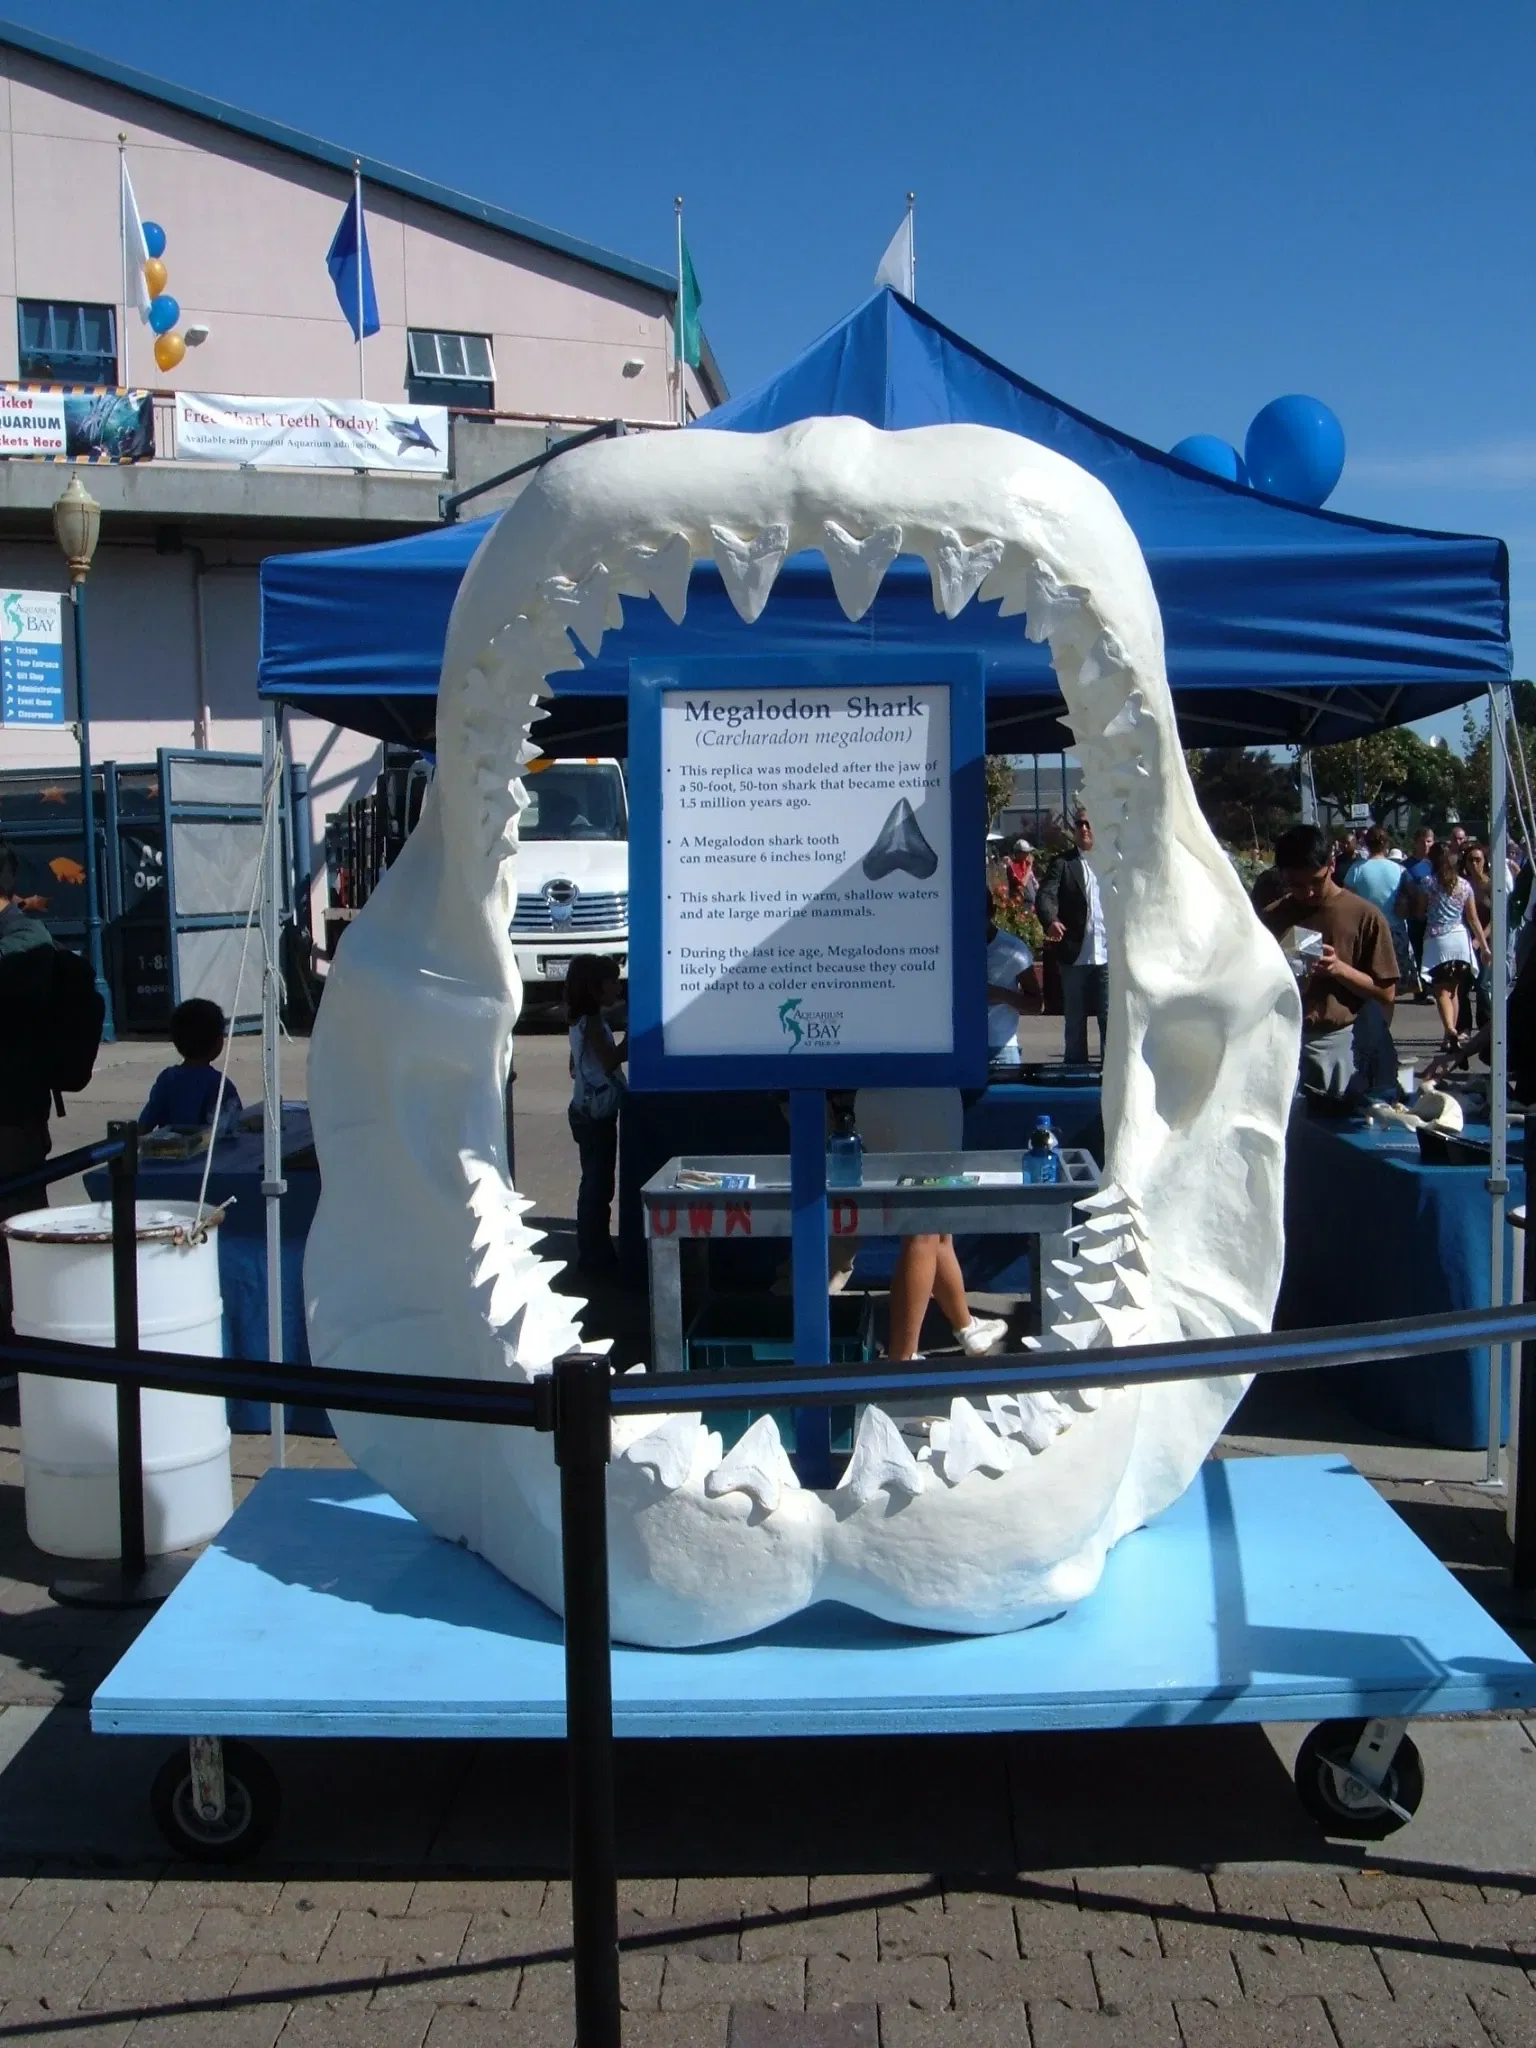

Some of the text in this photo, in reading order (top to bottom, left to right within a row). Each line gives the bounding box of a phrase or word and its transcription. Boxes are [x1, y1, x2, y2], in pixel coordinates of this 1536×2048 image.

[0, 416, 61, 430] UARIUM
[276, 413, 320, 429] Teeth
[327, 414, 379, 434] Today!
[0, 434, 62, 448] kets Here
[185, 434, 227, 446] Available
[229, 436, 249, 446] with
[250, 437, 274, 449] proof
[287, 440, 331, 449] Aquarium
[333, 440, 381, 450] adssion.
[27, 616, 55, 632] BAY
[684, 695, 924, 728] Megalodon Shark
[695, 726, 912, 748] (Carcharadon megalodon)
[680, 760, 938, 778] This replica was modeled after the jaw of
[679, 777, 941, 793] a 50-foot, 50-ton shark that became extinct
[680, 796, 811, 811] 1.5 million years ago.
[680, 834, 840, 850] A Megalodon shark tooth
[679, 850, 847, 864] can measure 6 inches long!
[680, 888, 939, 903] This shark lived in warm, shallow waters
[679, 905, 876, 921] and ate large marine mammals.
[680, 943, 940, 961] During the last ice age, Megalodons most
[680, 960, 936, 978] likely became extinct because they could
[680, 977, 896, 993] not adapt to a colder environment.
[794, 1009, 844, 1020] AQUARIUM
[807, 1023, 841, 1039] BAY
